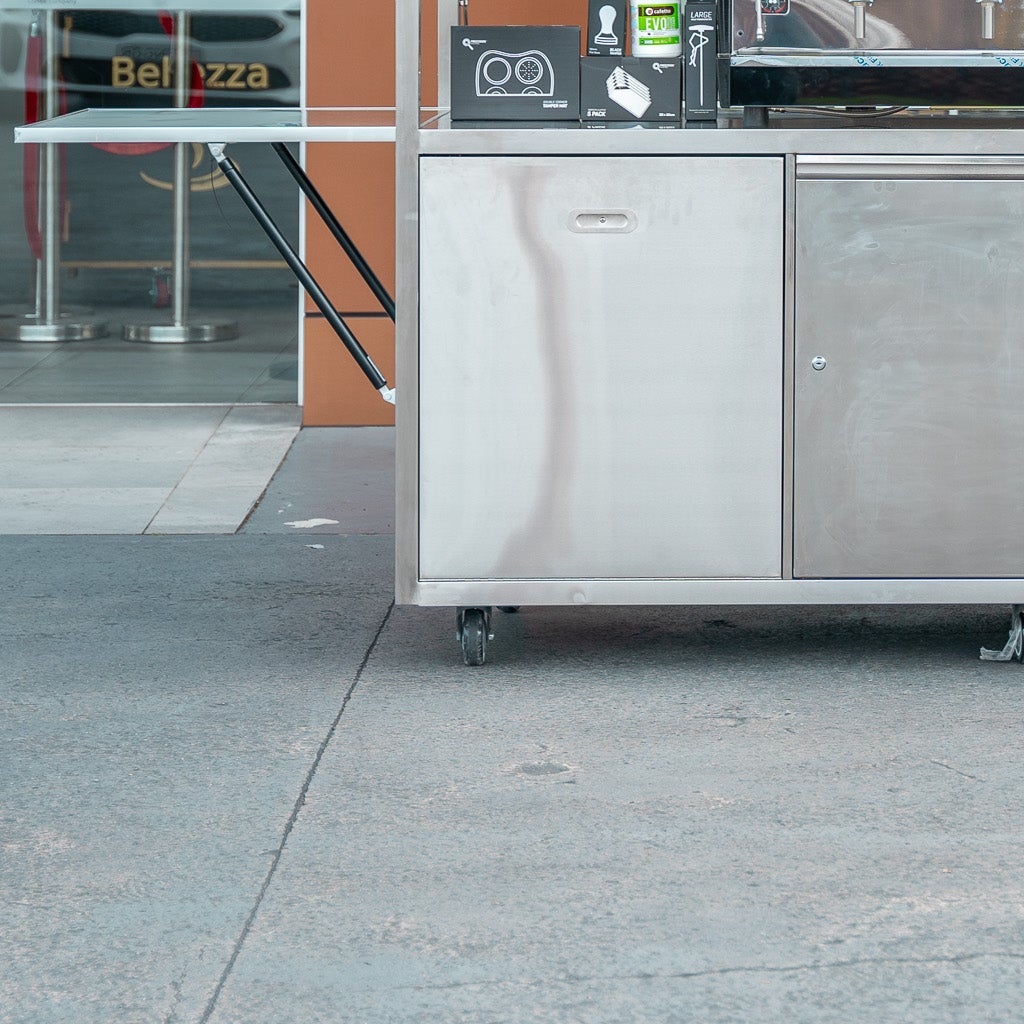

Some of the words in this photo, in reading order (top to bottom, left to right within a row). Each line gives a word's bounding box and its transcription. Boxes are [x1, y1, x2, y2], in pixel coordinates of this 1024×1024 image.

[690, 11, 713, 19] LARGE
[645, 17, 667, 31] EVO
[111, 56, 270, 89] Belzza
